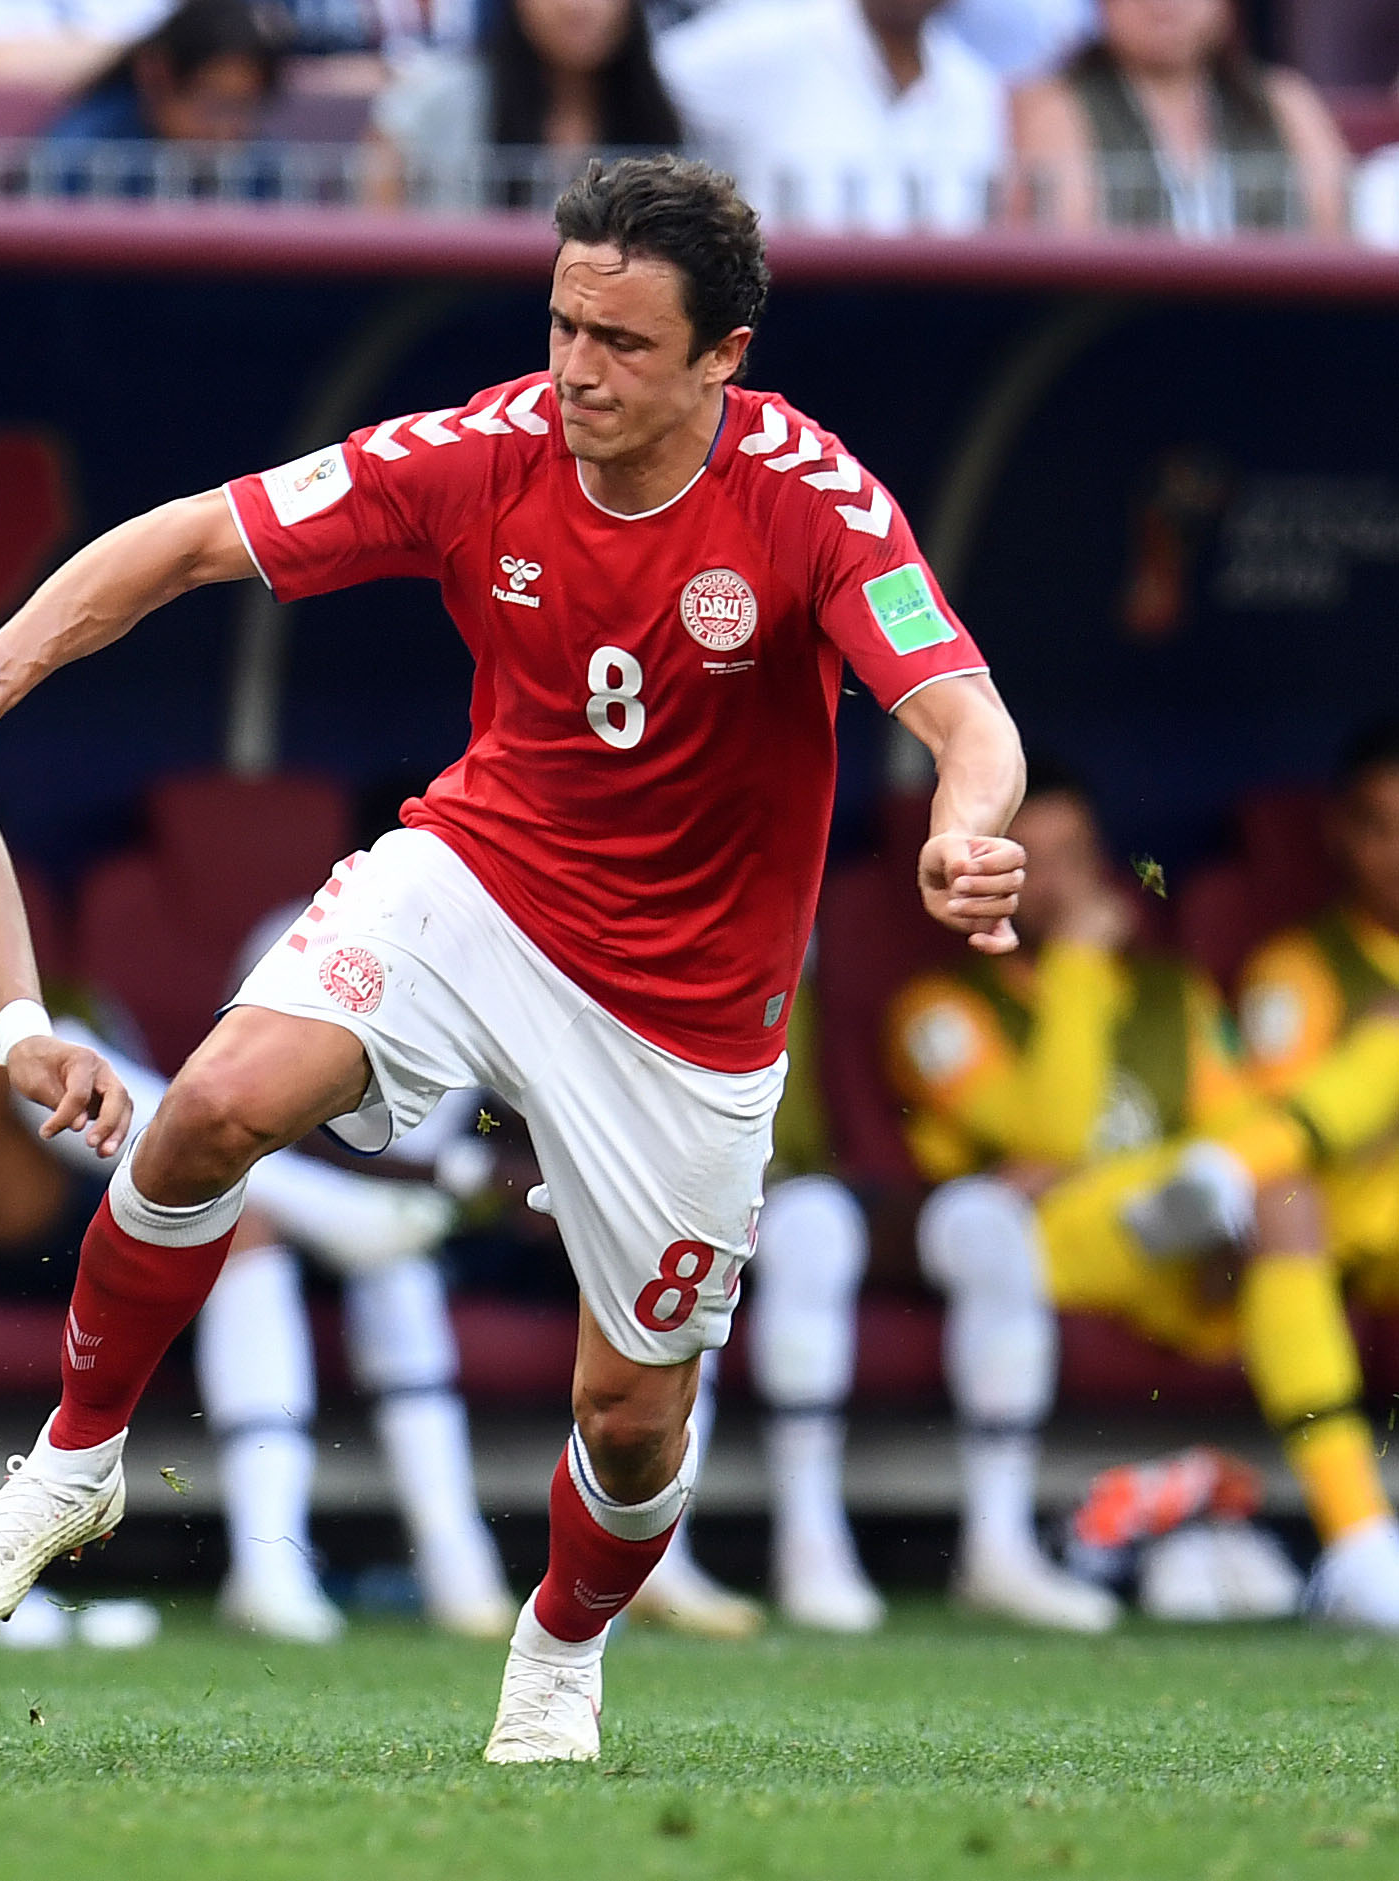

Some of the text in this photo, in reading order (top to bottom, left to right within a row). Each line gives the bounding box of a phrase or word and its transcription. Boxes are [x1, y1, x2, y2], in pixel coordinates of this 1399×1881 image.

[697, 595, 741, 621] DBU
[585, 645, 645, 750] 8
[331, 959, 374, 1000] DBU
[634, 1238, 715, 1333] 8
